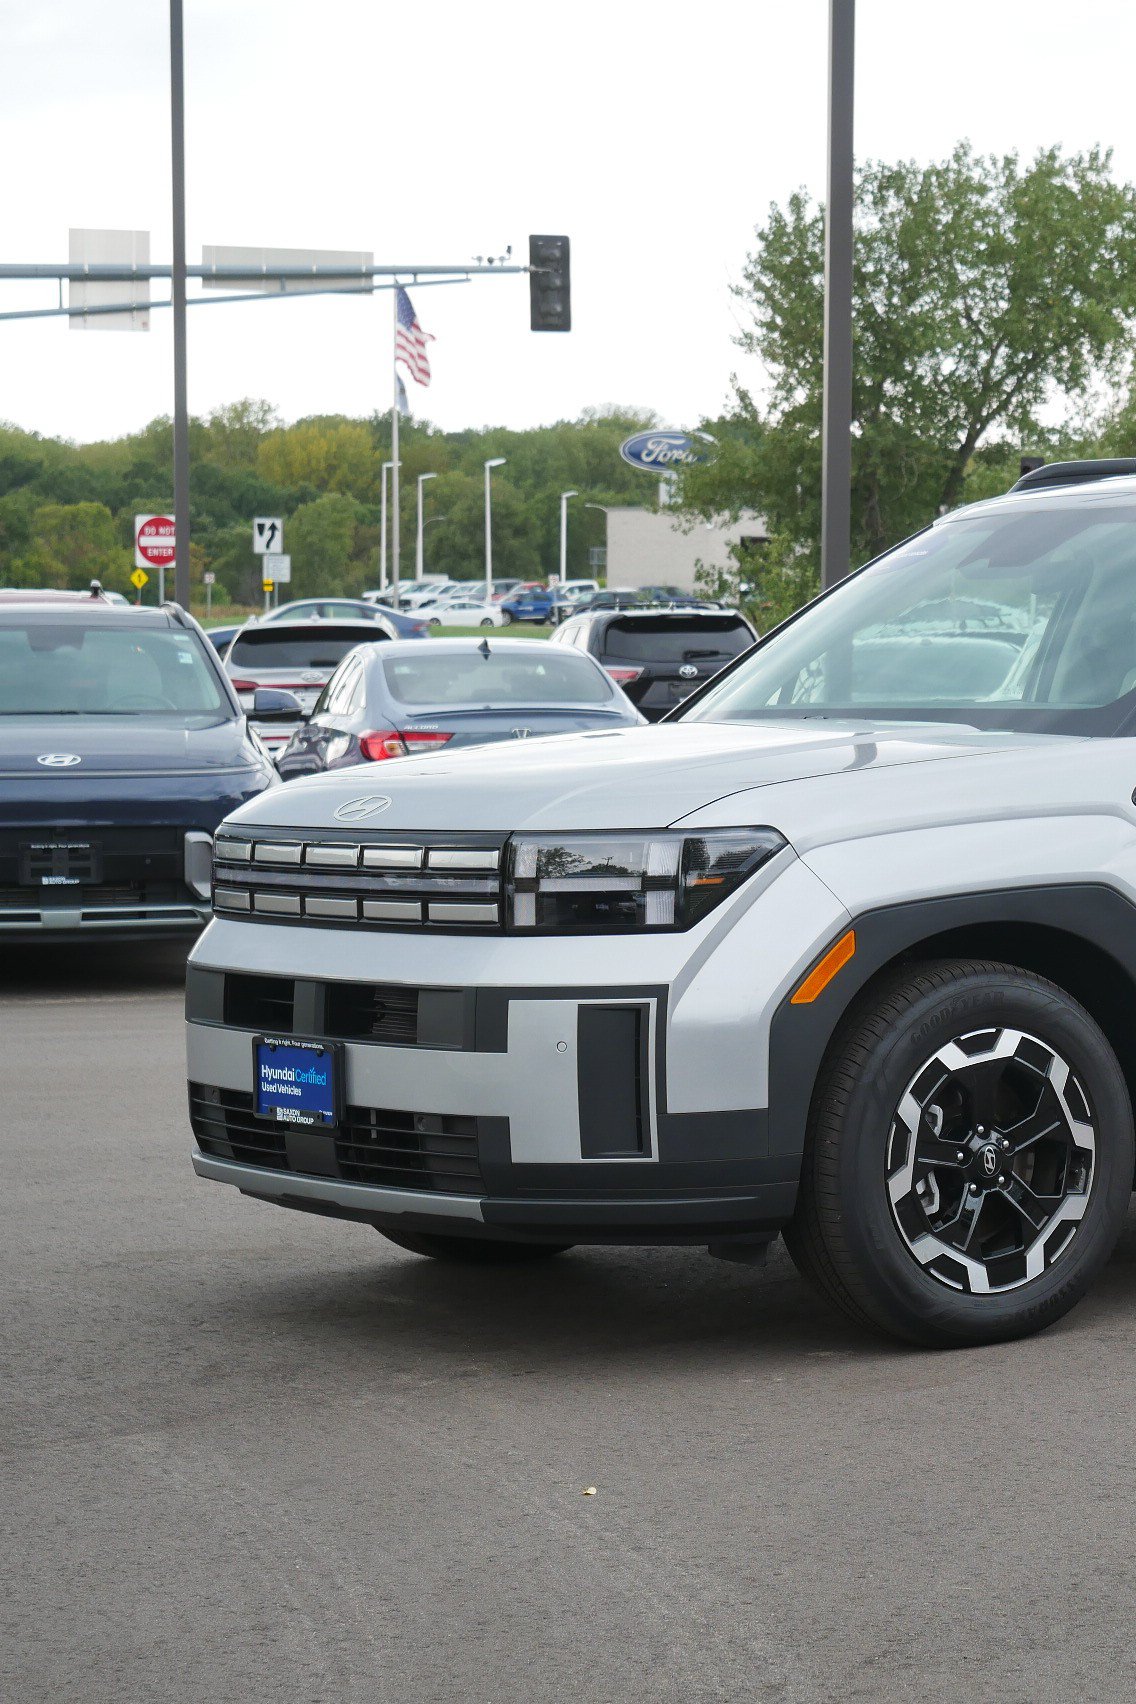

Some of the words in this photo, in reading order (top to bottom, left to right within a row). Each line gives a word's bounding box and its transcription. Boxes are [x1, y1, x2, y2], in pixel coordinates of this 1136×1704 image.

[144, 525, 157, 536] DO
[158, 525, 176, 536] NOT
[147, 547, 174, 557] ENTER
[261, 1064, 295, 1082] Hyundai
[295, 1066, 327, 1086] Certified
[261, 1081, 277, 1093] Used
[277, 1083, 302, 1097] Vehicles
